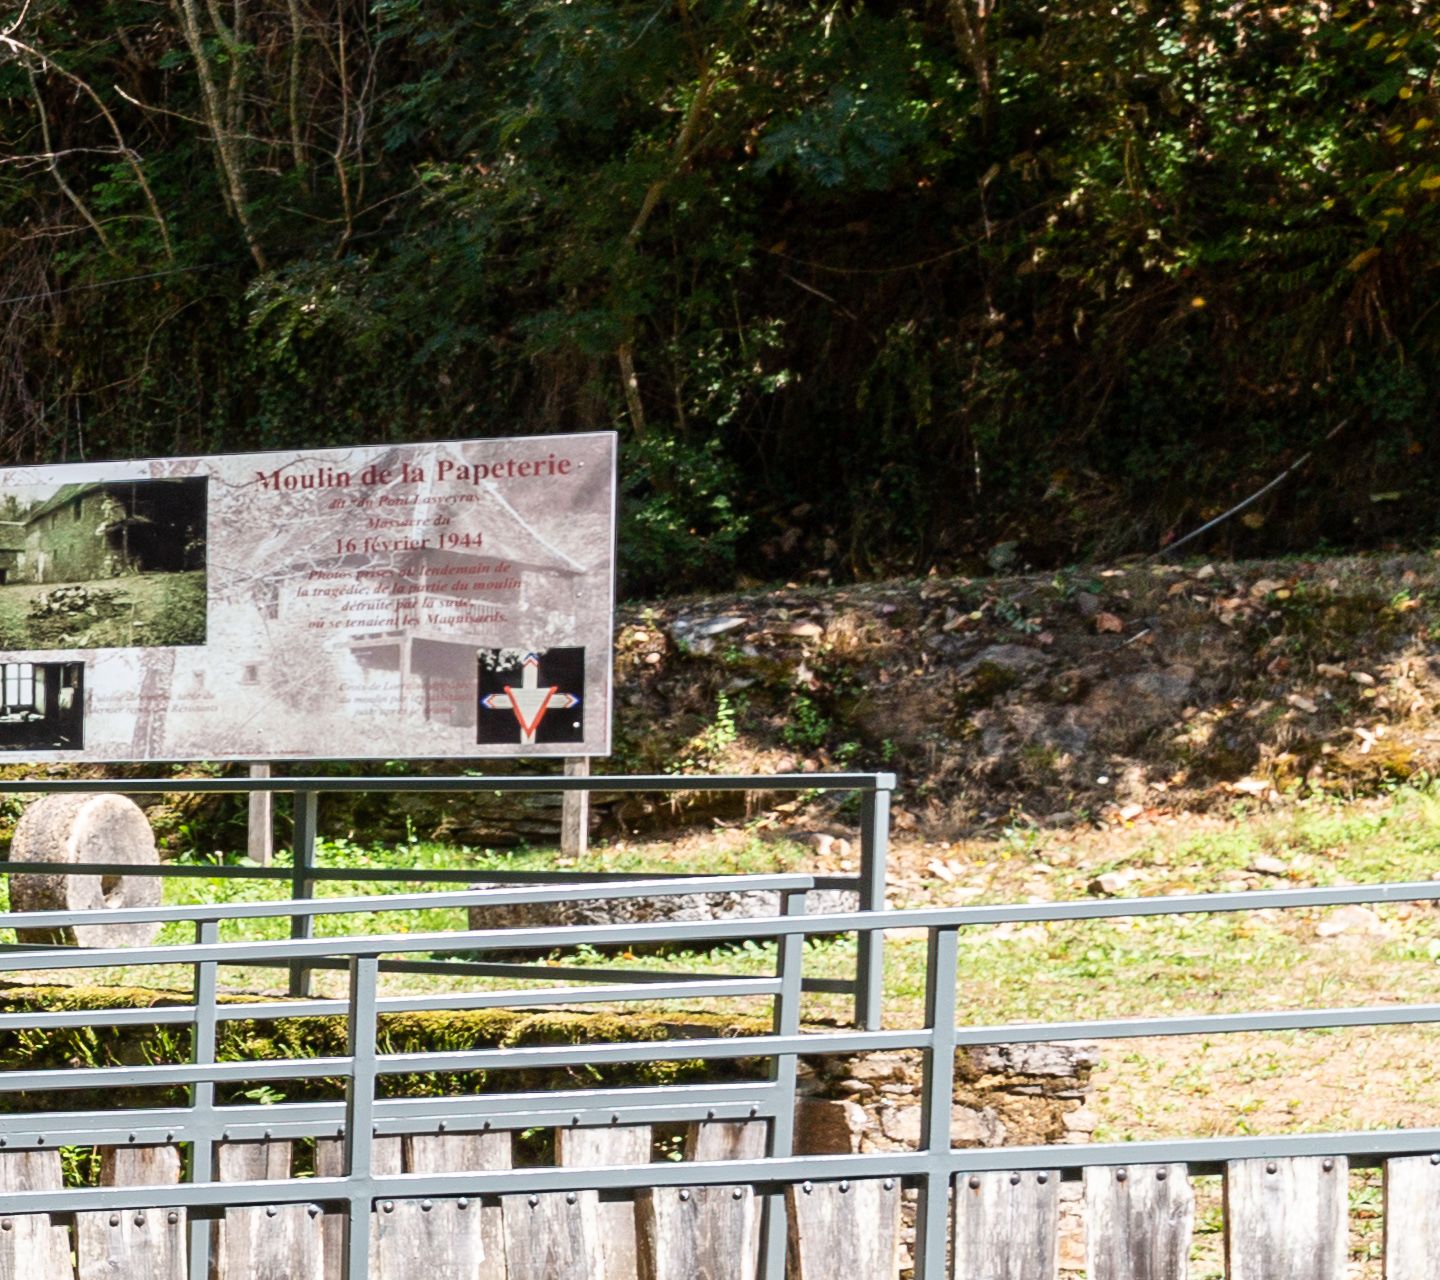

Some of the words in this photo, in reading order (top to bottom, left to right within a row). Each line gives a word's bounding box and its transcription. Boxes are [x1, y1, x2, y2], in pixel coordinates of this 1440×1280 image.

[256, 467, 351, 491] Moulin
[361, 463, 393, 486] de
[402, 462, 425, 483] la
[437, 453, 572, 485] Papeterie
[433, 514, 451, 526] du
[336, 538, 357, 554] 16
[363, 534, 431, 552] février
[438, 531, 484, 550] 1944
[308, 570, 353, 580] Photos
[356, 568, 394, 581] prises
[419, 564, 491, 577] lendemain
[495, 562, 512, 573] de
[296, 586, 309, 598] la
[373, 584, 389, 594] de
[392, 582, 405, 594] la
[451, 579, 468, 591] du
[472, 577, 522, 590] moulin
